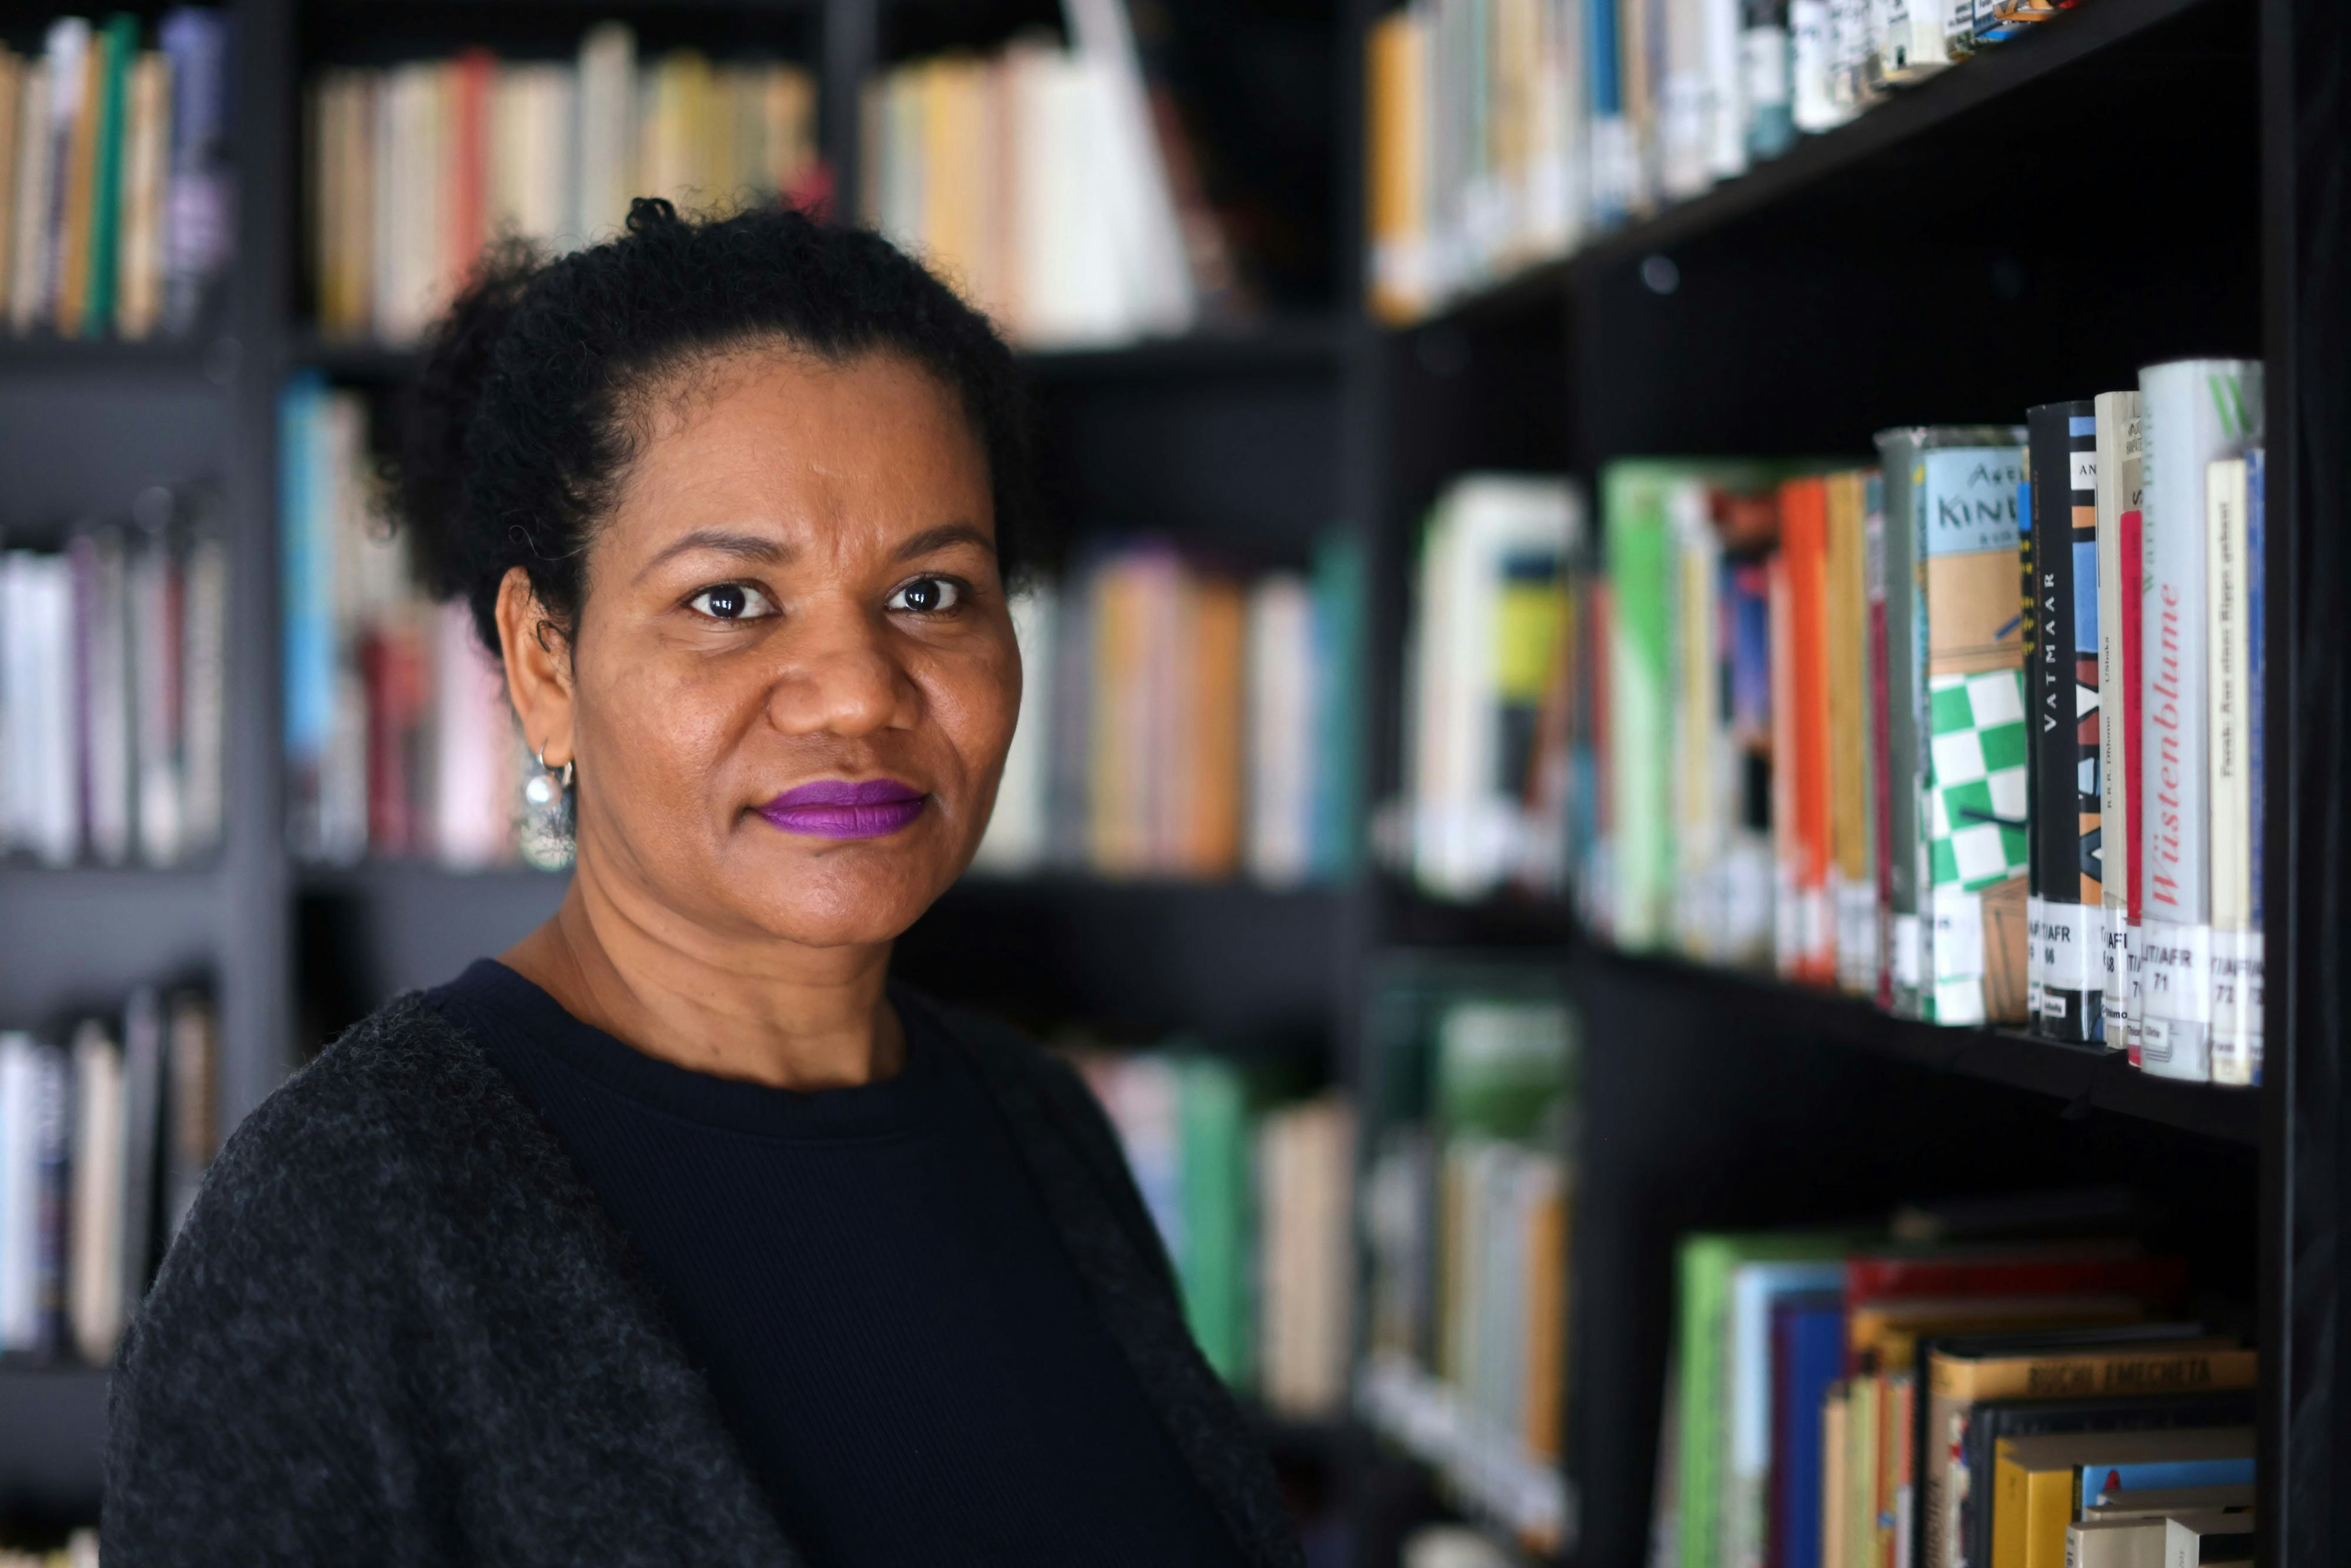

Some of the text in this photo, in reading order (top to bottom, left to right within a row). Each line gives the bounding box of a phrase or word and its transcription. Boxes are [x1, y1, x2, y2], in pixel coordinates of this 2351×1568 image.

[2044, 573, 2057, 732] VATMAAR
[2152, 583, 2180, 907] Wüstenblume
[2154, 973, 2168, 991] 71
